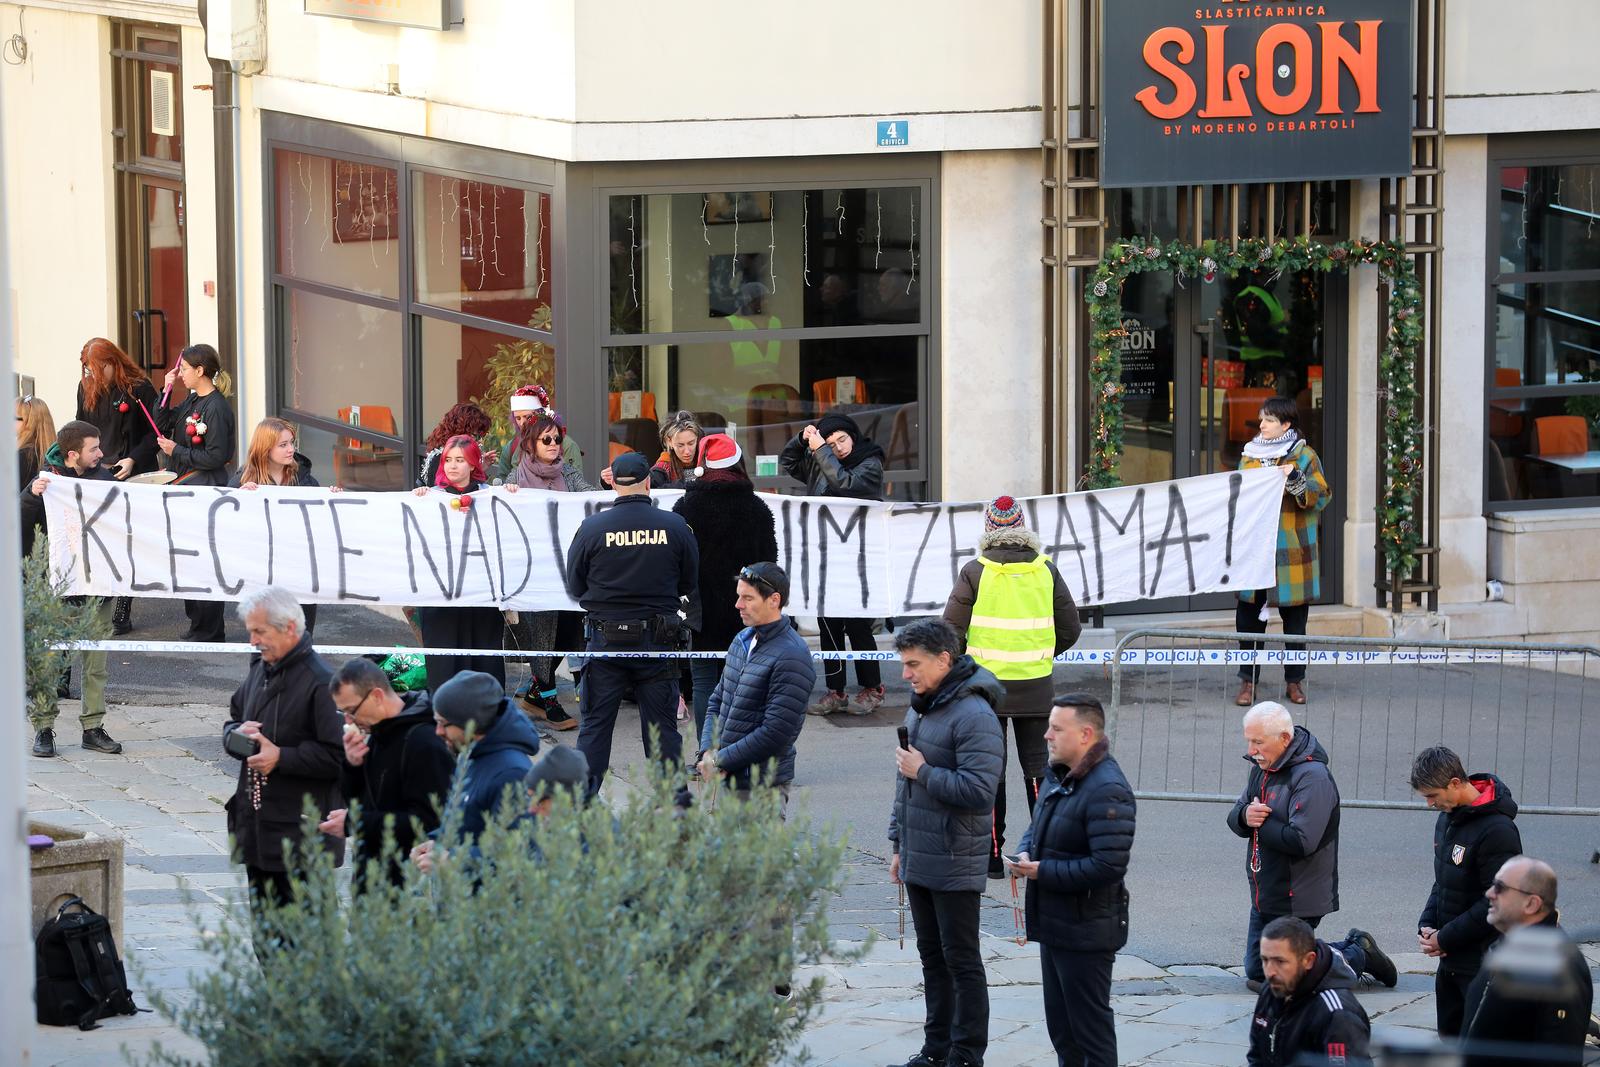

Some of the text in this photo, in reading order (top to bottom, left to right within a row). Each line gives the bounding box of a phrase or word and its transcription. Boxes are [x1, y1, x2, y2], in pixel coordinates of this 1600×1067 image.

[1195, 5, 1326, 19] SLASTIČARNICA
[1135, 20, 1383, 120] SLON
[887, 123, 896, 138] 4
[1164, 119, 1355, 135] BY MORENO DEBARTOLI
[74, 482, 380, 601] KLEČITE
[400, 495, 533, 602] NAD
[605, 529, 668, 547] POLICIJA
[860, 652, 894, 660] STOP
[1146, 651, 1206, 662] POLICIJA
[1224, 651, 1258, 662] STOP
[1267, 651, 1327, 662] POLICIJA
[1345, 651, 1378, 661] STOP
